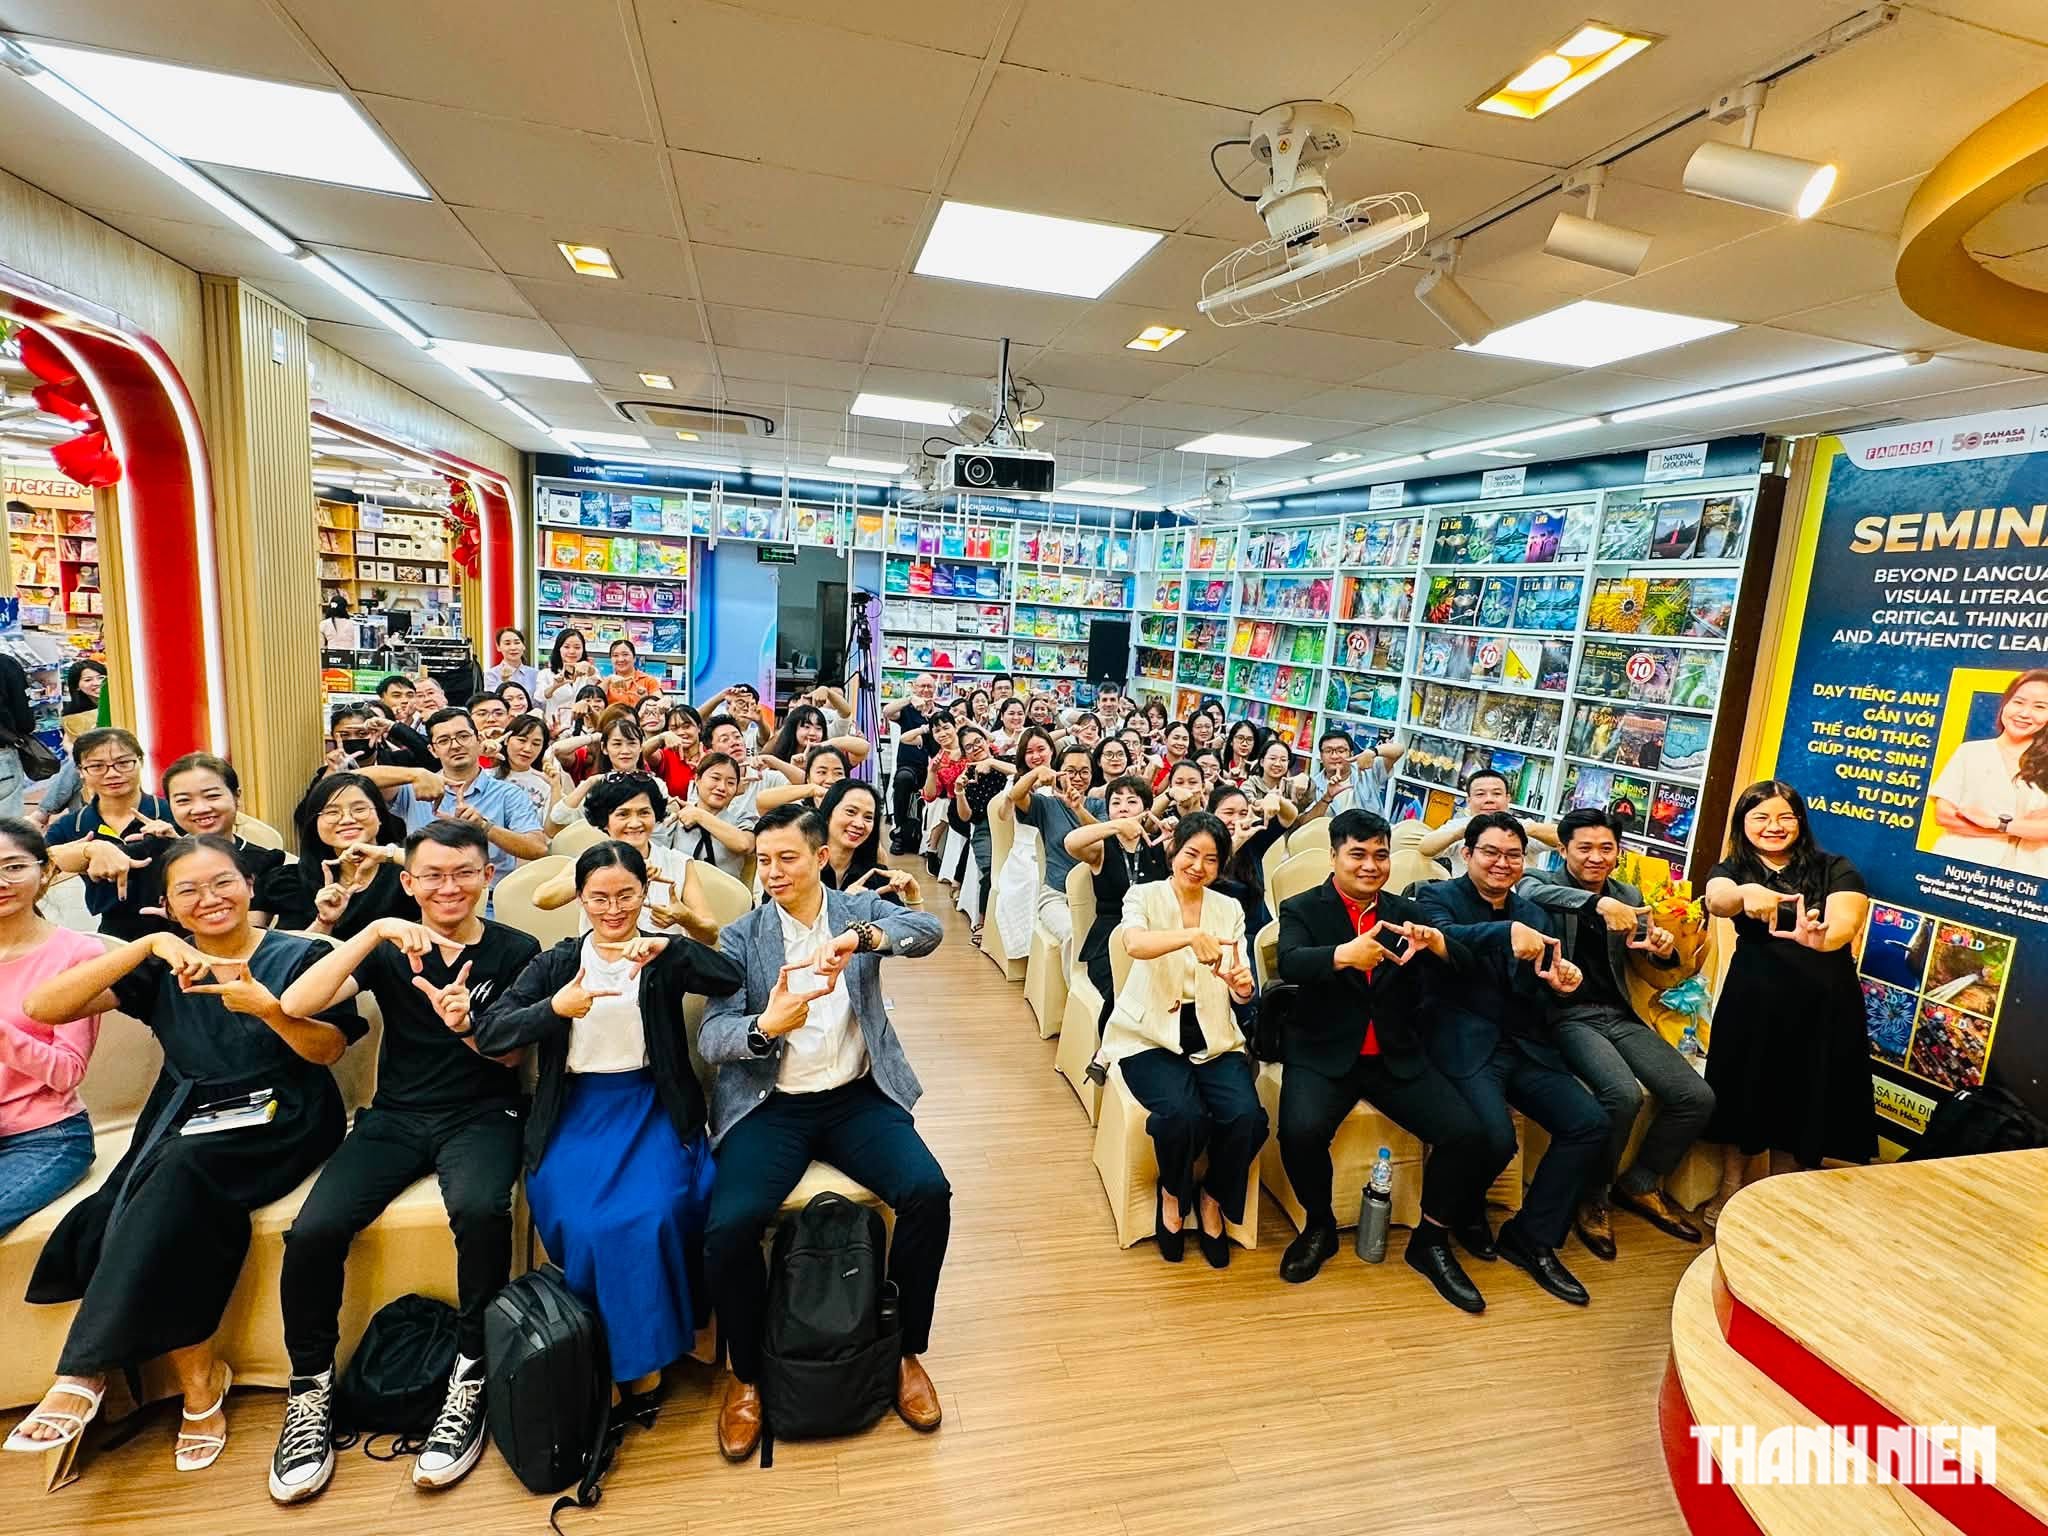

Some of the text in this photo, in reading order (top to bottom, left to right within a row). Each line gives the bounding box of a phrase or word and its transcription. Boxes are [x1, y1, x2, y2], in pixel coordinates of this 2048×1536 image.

[1984, 428, 2025, 439] FAHASA
[1663, 451, 1694, 462] NATIONAL
[1866, 440, 1933, 460] FAHASA
[1535, 514, 1548, 523] Life
[1849, 504, 2048, 554] SEMIN
[1874, 567, 1958, 583] BEYOND
[1884, 589, 1953, 604] VISUAL
[1871, 610, 1959, 626] CRITICAL
[1350, 638, 1365, 649] 10
[1832, 629, 1873, 644] AND
[1876, 631, 1993, 649] AUTHENTIC
[1482, 650, 1496, 664] 10
[1631, 663, 1651, 678] 10
[1812, 683, 1940, 707] DẠY TIẾNG ANH
[1863, 704, 1936, 728] GẮN VỚI
[1811, 720, 1844, 736] THẾ
[1844, 724, 1878, 741] GIỚI
[1807, 739, 1927, 769] GIÚP HỌC SINH
[1835, 764, 1922, 791] QUAN SÁT,
[1658, 790, 1696, 804] READING
[1856, 786, 1919, 808] TƯ DUY
[1806, 795, 1915, 829] VÀ SÁNG TẠO
[1989, 875, 2015, 893] Huệ
[2017, 881, 2039, 897] Chi
